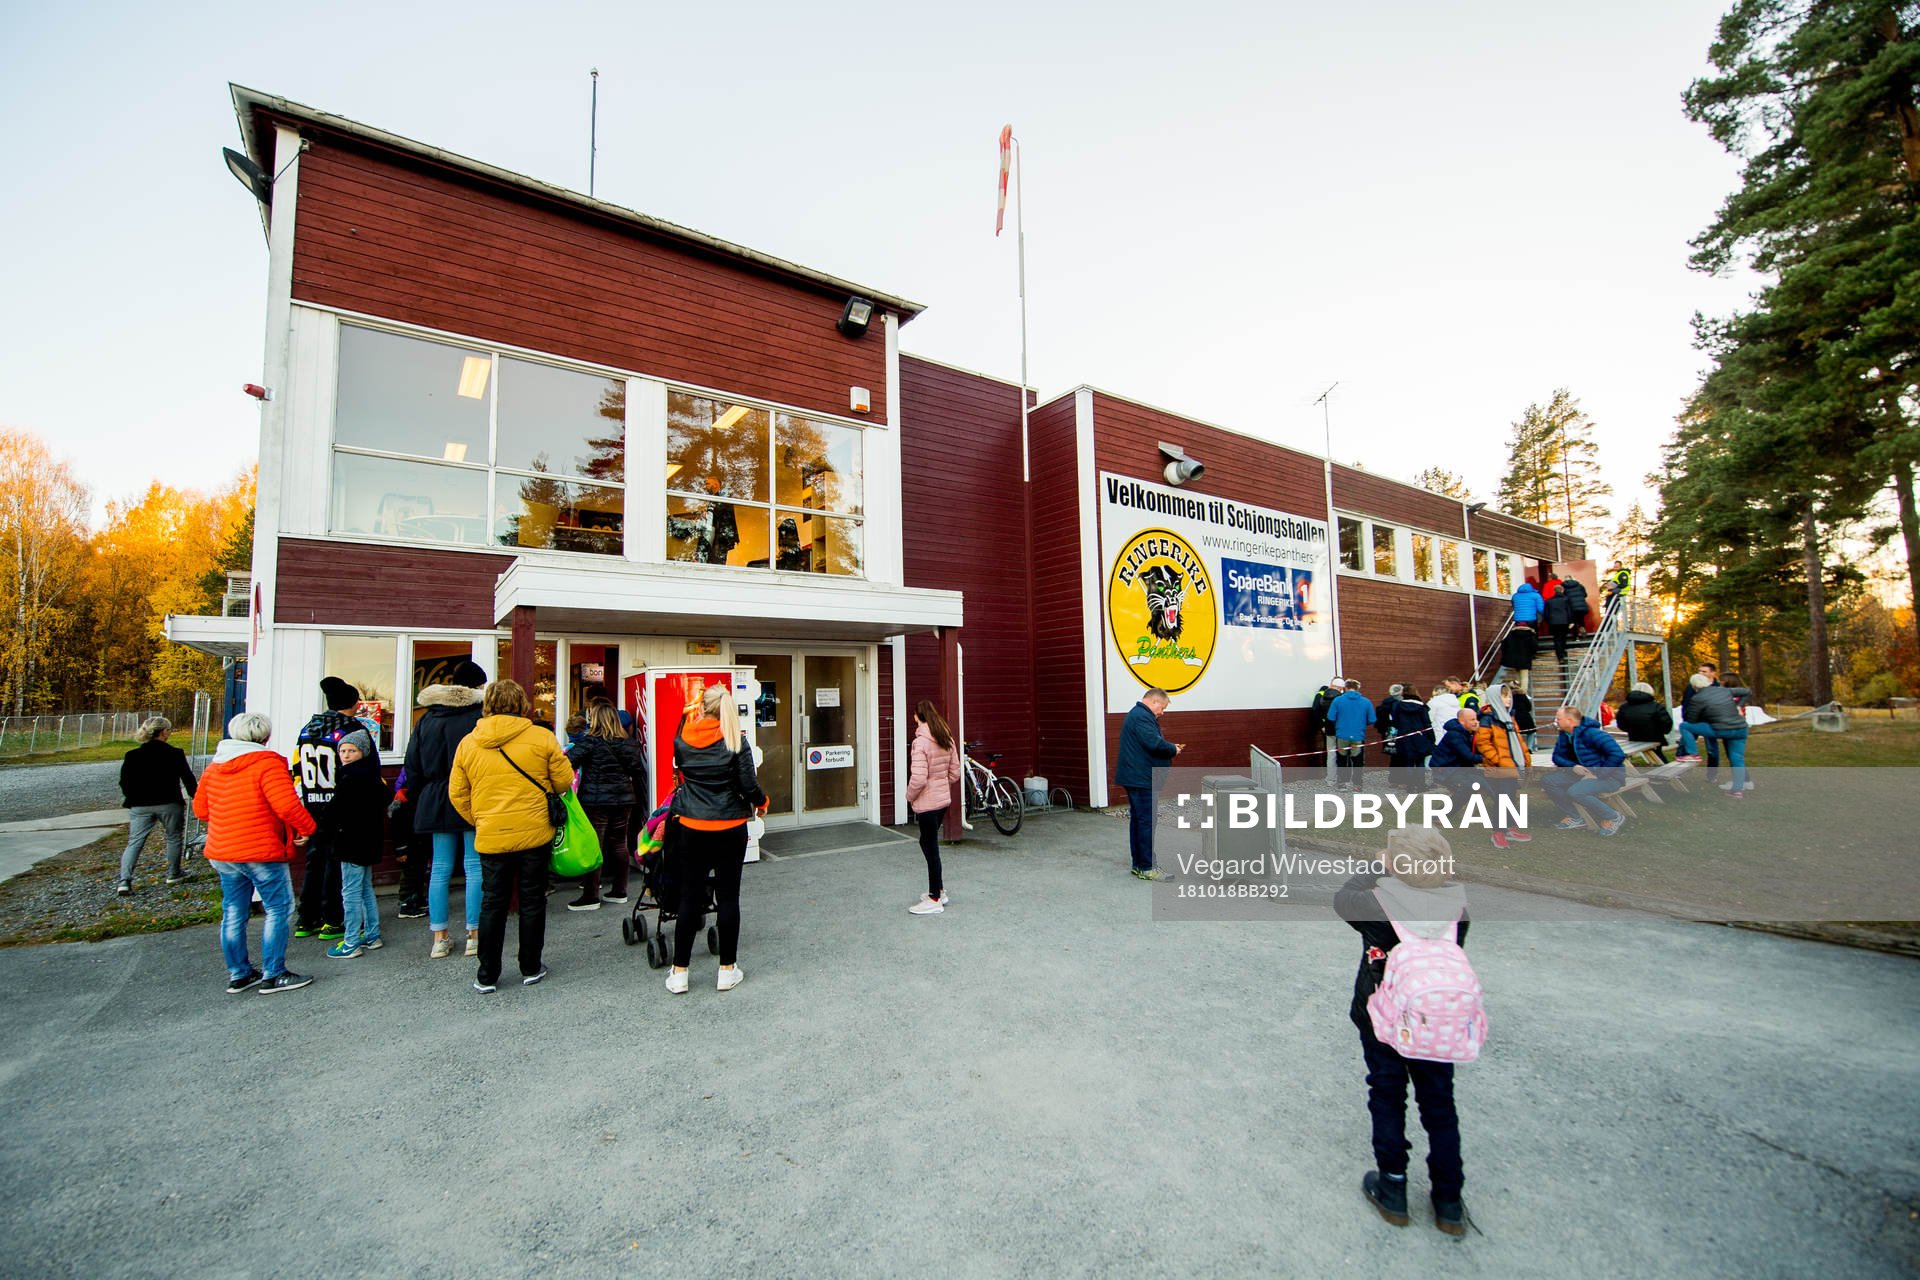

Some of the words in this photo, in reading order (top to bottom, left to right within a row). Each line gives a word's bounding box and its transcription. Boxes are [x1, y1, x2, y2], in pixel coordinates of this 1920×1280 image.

[1106, 477, 1206, 521] Velkommen
[1208, 501, 1224, 525] til
[1227, 504, 1325, 544] Schjongshallen
[1118, 538, 1207, 595] RINGERIKE
[1202, 535, 1326, 566] www.ringerikepanthers
[1228, 569, 1292, 595] SpareBank
[1300, 584, 1309, 604] 1
[1136, 636, 1197, 660] Panthers
[300, 743, 336, 789] 60
